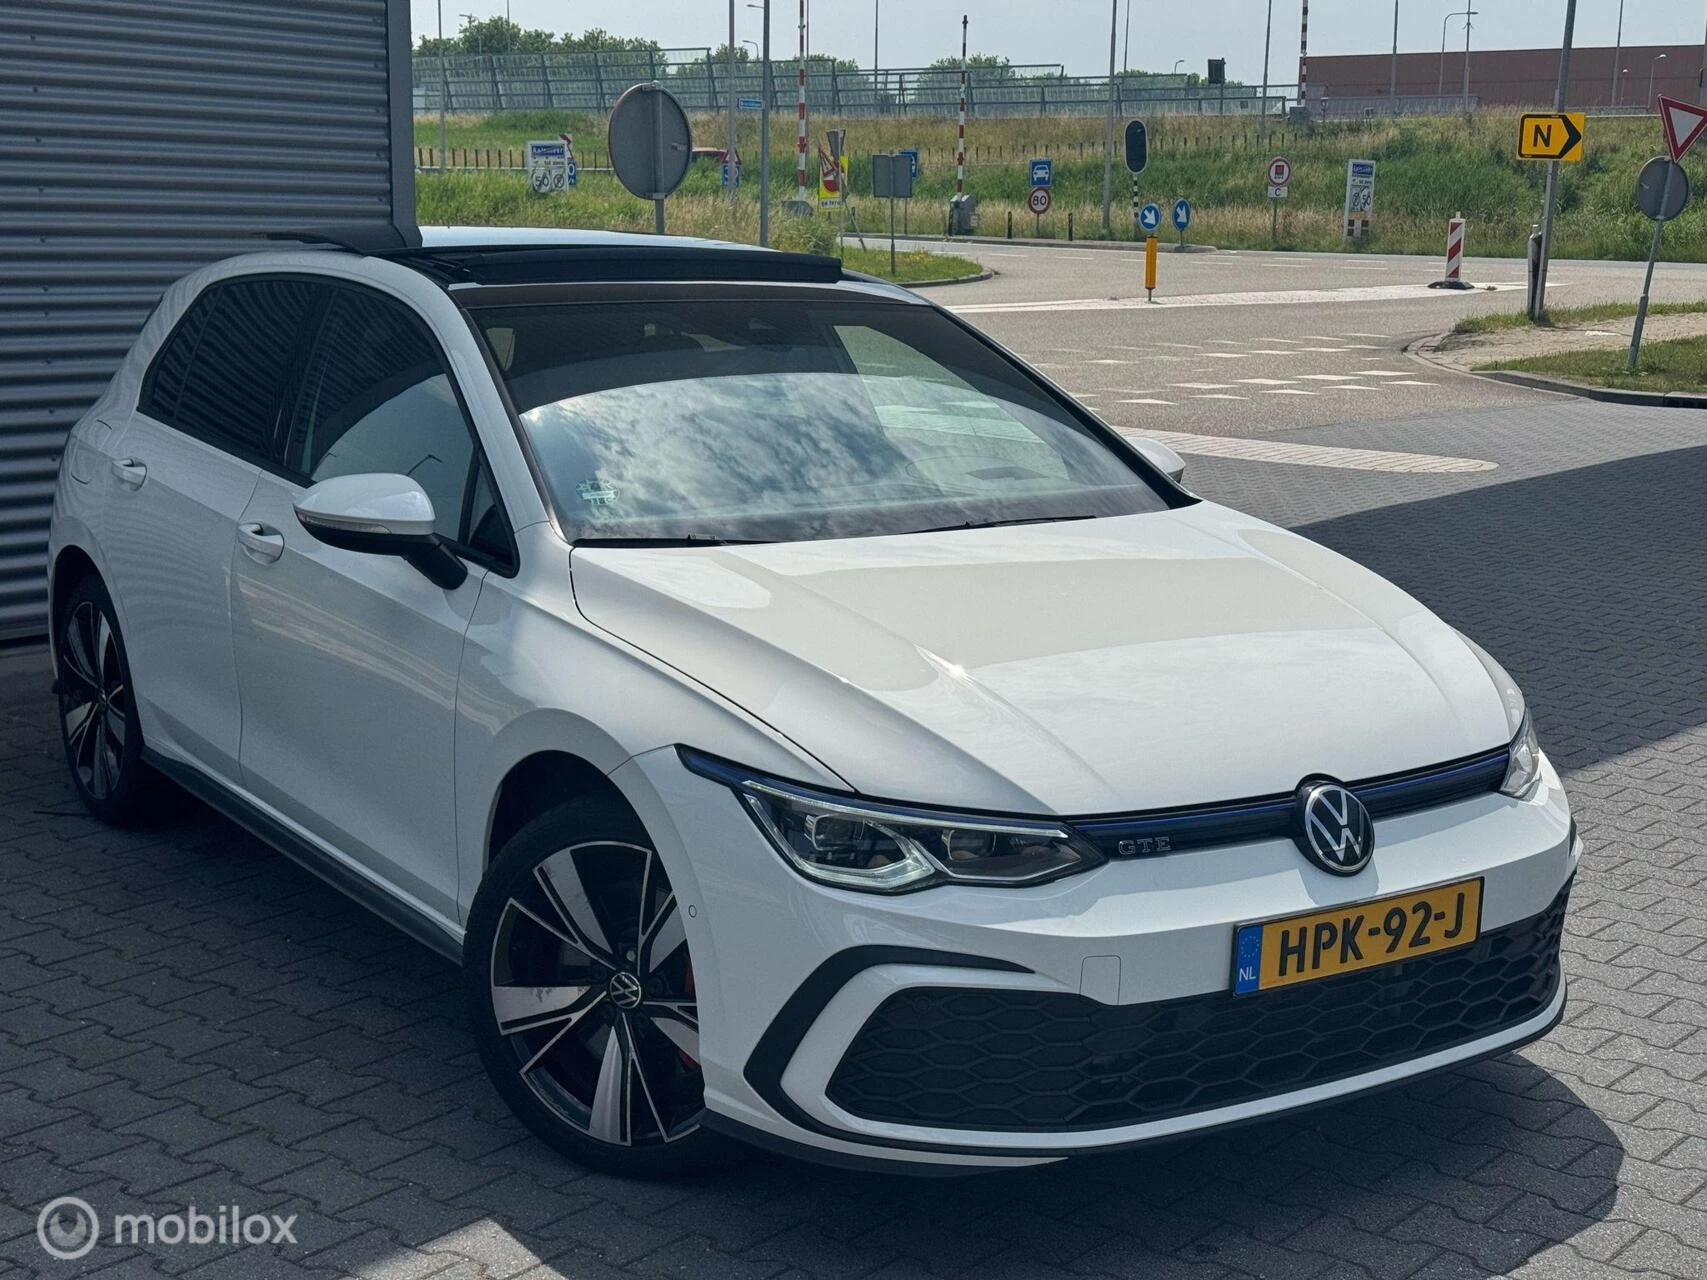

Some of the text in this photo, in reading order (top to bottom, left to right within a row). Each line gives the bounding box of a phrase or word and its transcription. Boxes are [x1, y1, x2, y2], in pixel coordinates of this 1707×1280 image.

[1533, 124, 1552, 148] N
[1032, 195, 1047, 206] 80
[1274, 187, 1282, 197] C
[1118, 836, 1171, 855] GTE
[1278, 892, 1465, 977] HPK-92-J
[1238, 966, 1257, 983] NL
